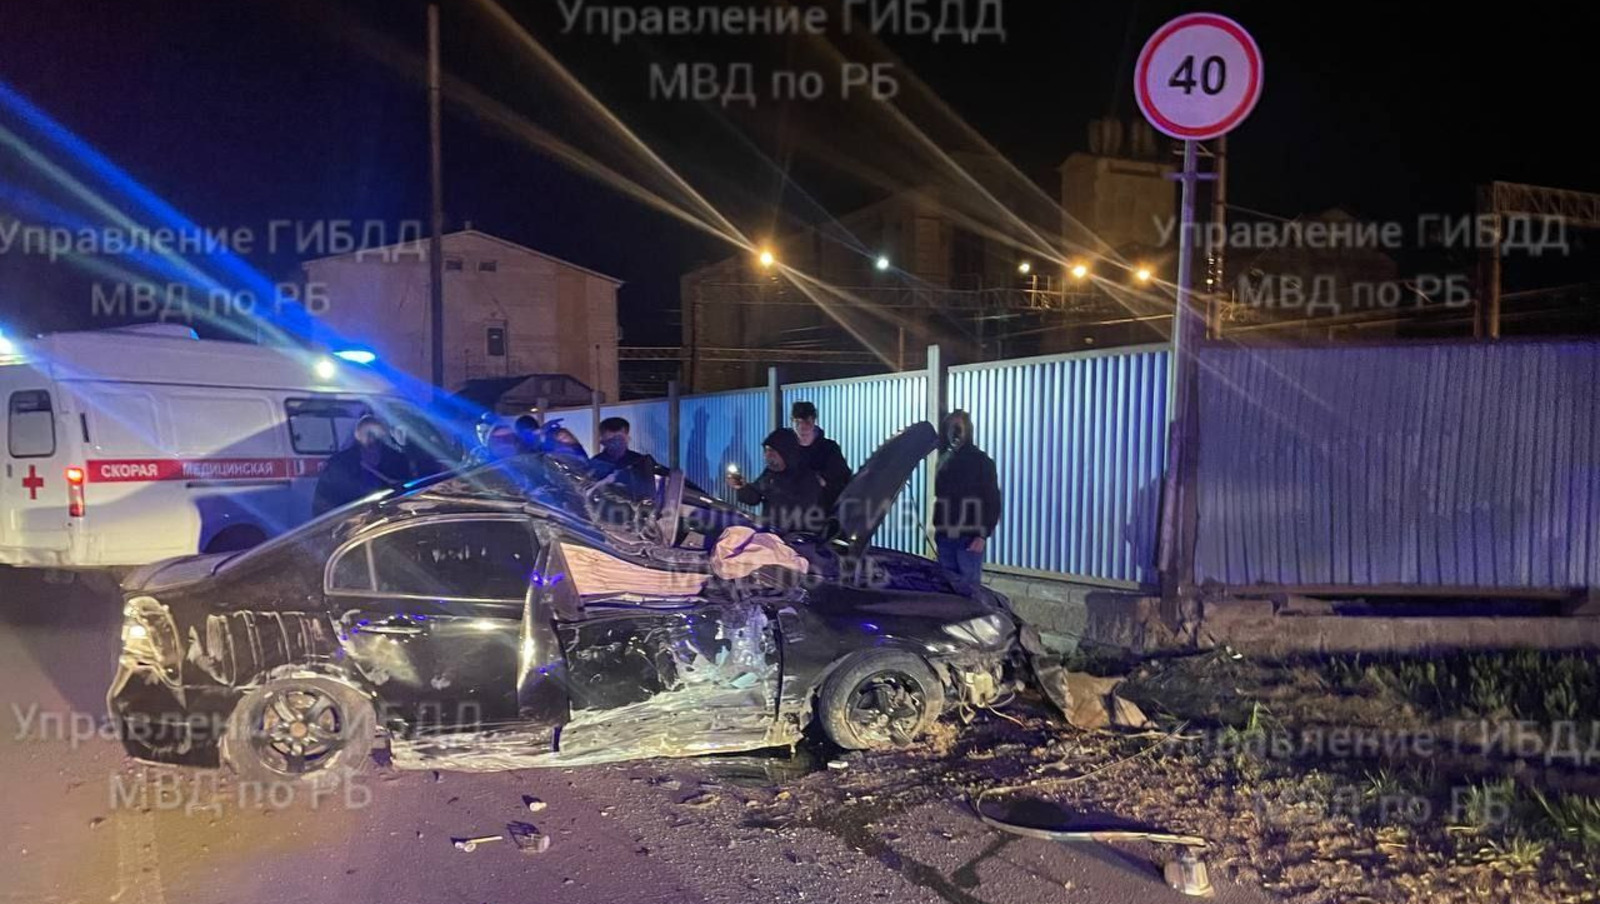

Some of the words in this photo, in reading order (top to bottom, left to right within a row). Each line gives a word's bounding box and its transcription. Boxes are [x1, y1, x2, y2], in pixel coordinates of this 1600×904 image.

[1168, 55, 1227, 96] 40
[101, 464, 158, 478] СКОРАЯ
[183, 462, 273, 476] МЕДИЦИНСКАЯ
